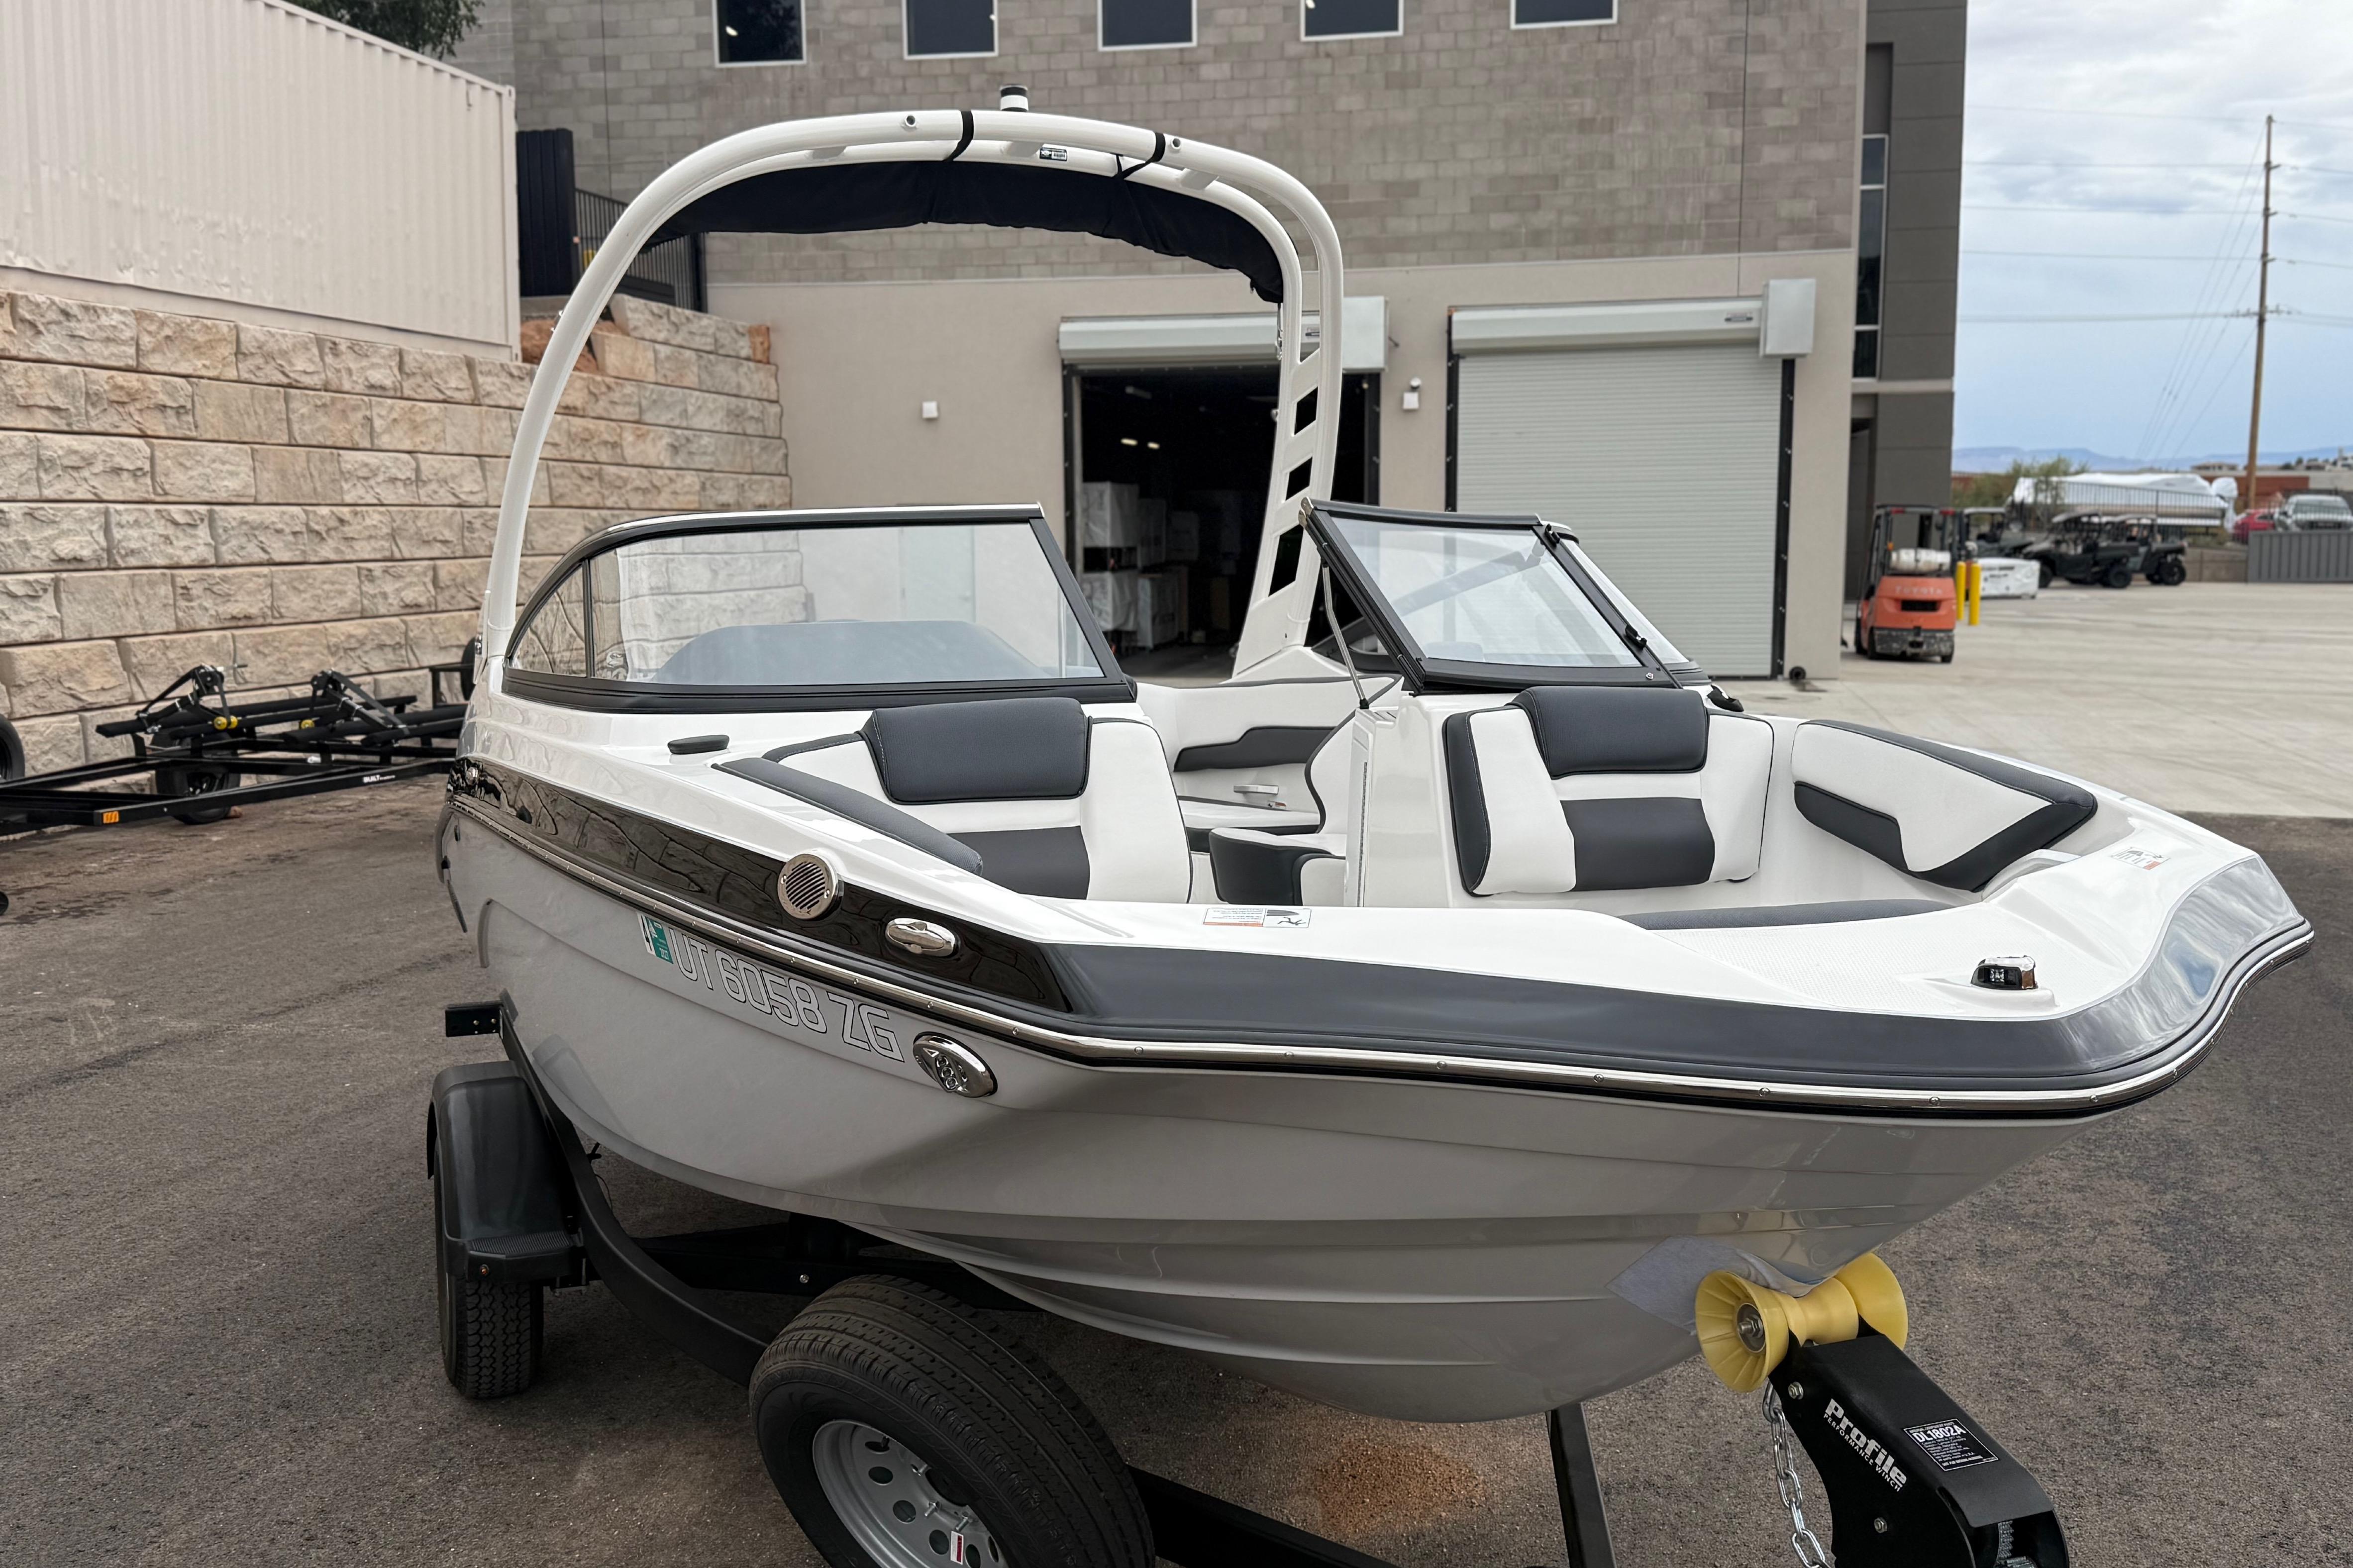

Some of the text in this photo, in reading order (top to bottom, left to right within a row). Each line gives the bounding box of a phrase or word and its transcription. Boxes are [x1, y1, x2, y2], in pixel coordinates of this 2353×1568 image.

[668, 927, 905, 1063] UT 6058 ZG
[1824, 1413, 1901, 1492] PERFORMANCE WINCH
[1825, 1398, 1907, 1487] Profile
[1912, 1425, 1967, 1443] DL1802A
